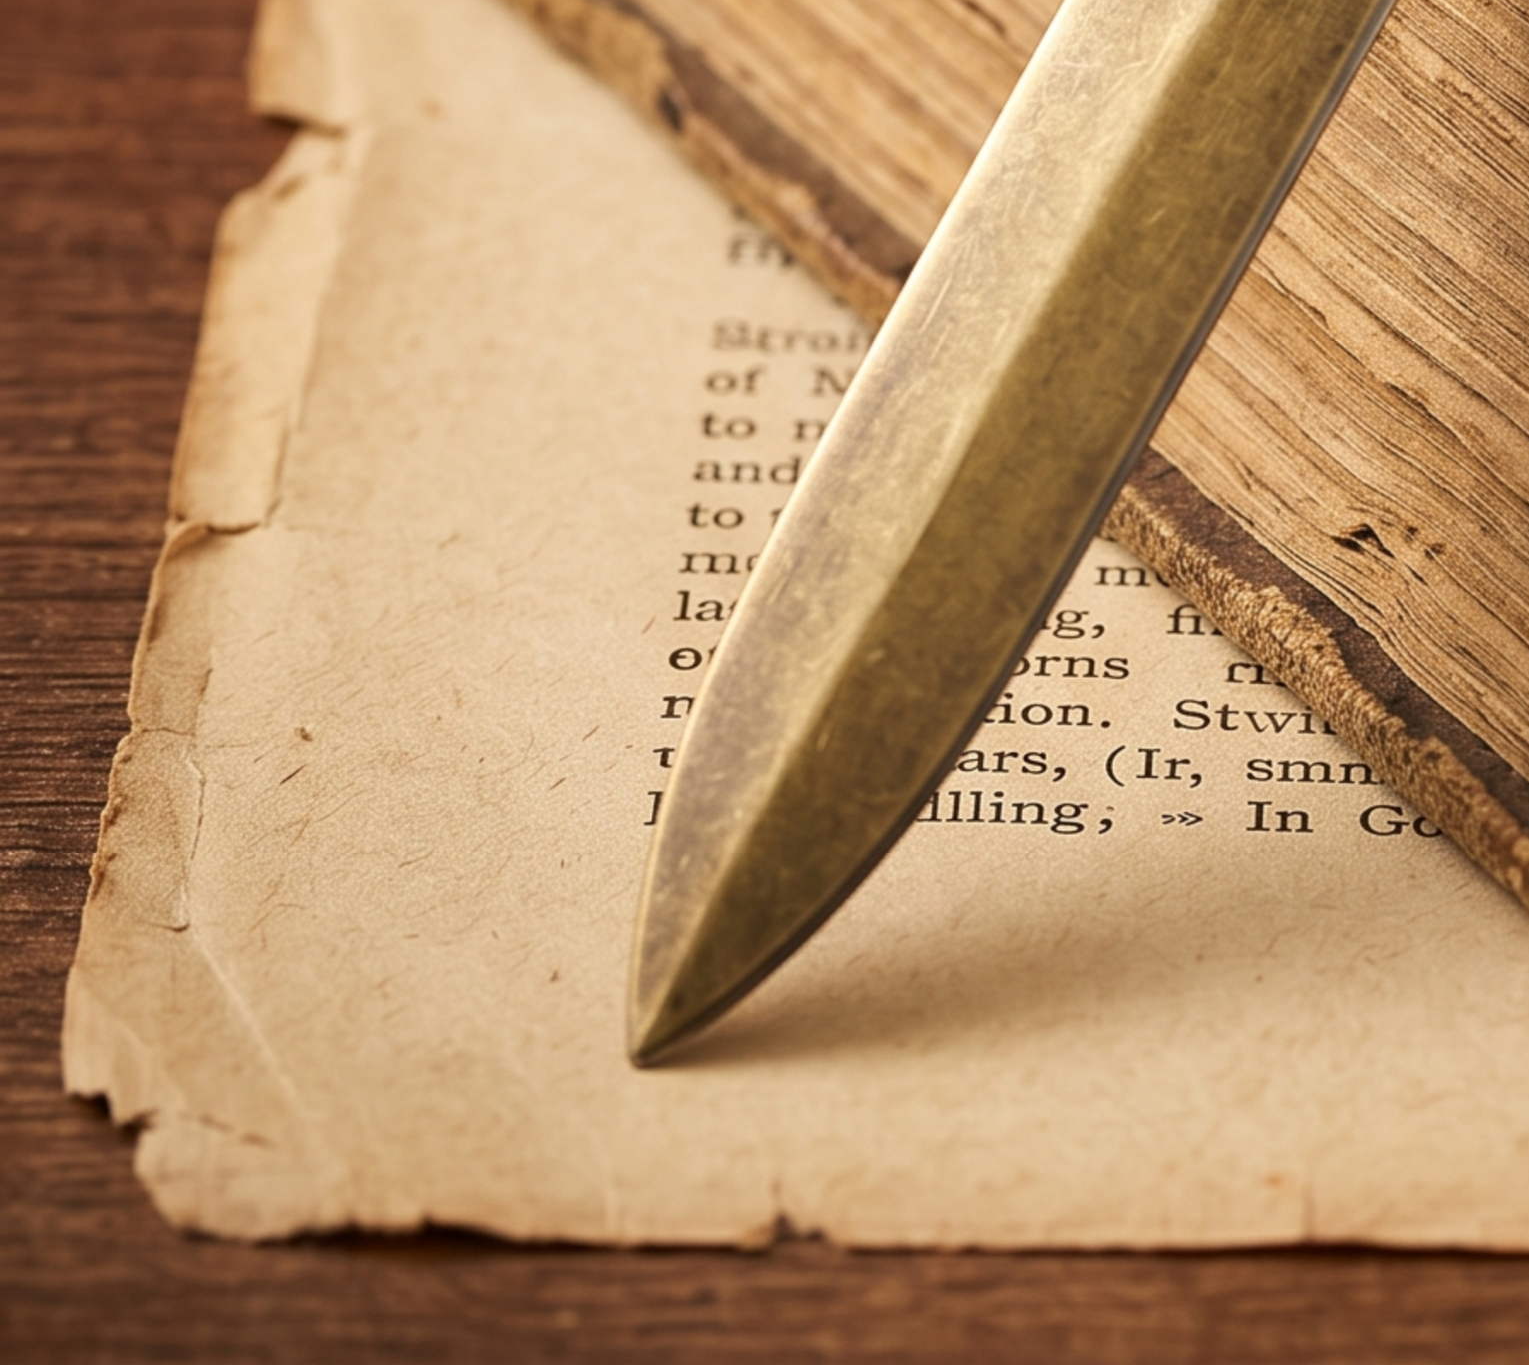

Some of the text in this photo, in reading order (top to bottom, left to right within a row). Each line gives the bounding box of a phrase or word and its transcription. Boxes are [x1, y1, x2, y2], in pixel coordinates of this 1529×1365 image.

[704, 366, 767, 395] of
[701, 411, 757, 441] to
[692, 456, 802, 485] and
[686, 502, 745, 529] to
[1246, 801, 1314, 833] In
